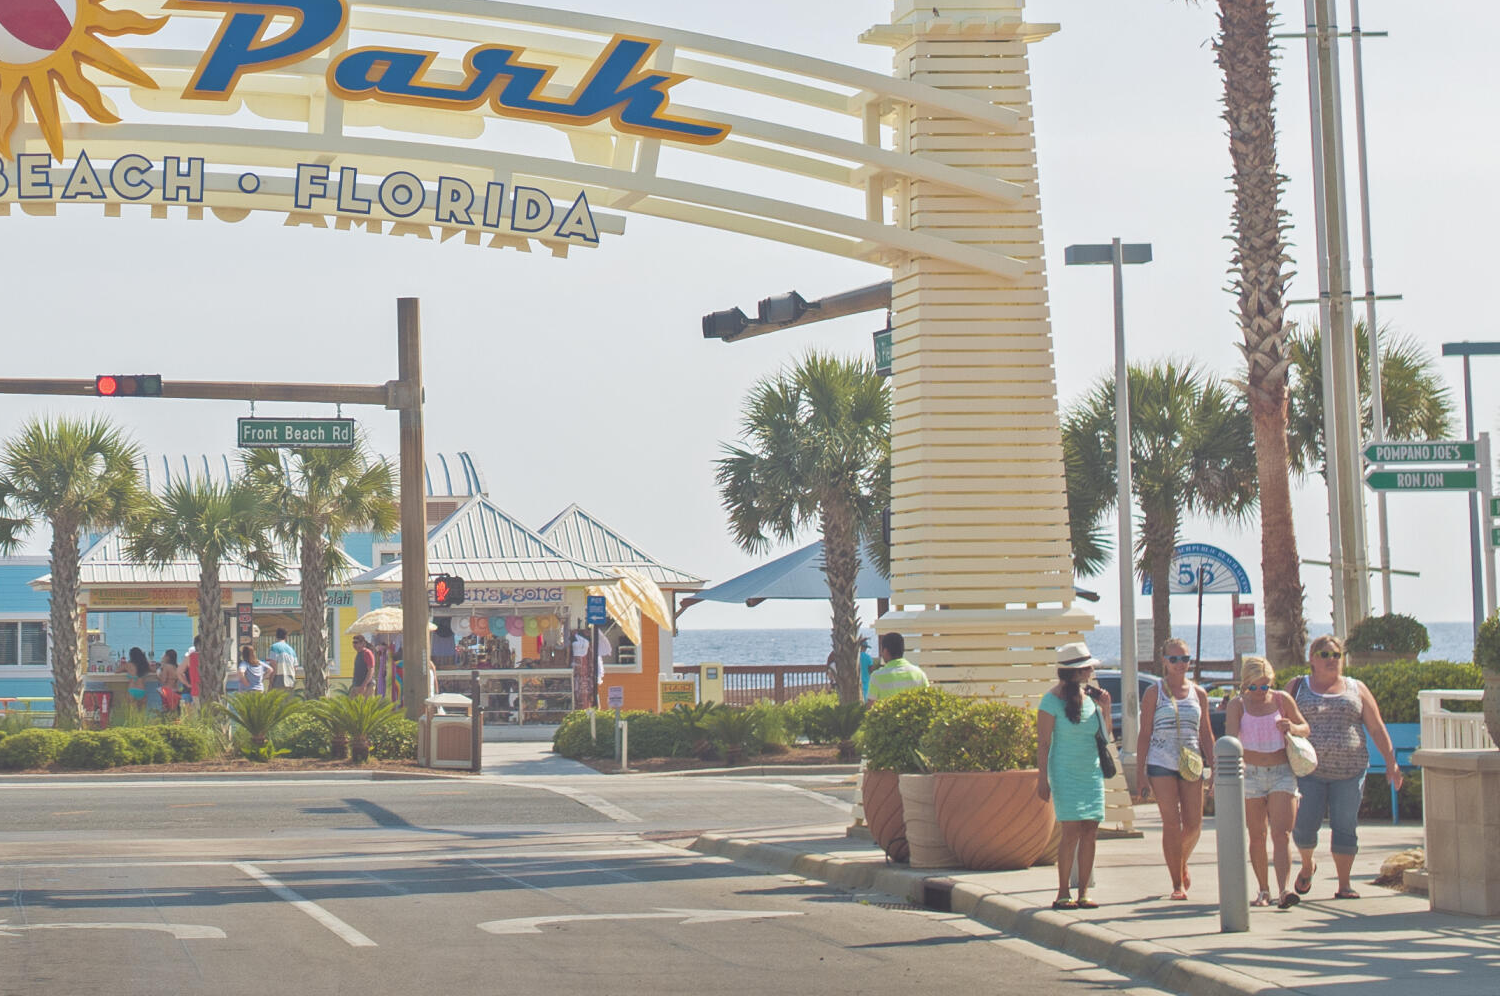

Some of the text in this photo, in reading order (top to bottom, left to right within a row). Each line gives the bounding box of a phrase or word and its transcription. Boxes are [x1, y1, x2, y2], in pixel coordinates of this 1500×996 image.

[294, 162, 601, 244] FLORIDA
[243, 425, 349, 440] Front Beach Rd
[1376, 445, 1461, 461] POMPANO JOE'S
[1397, 473, 1444, 487] RON JON
[260, 593, 295, 605] Italian
